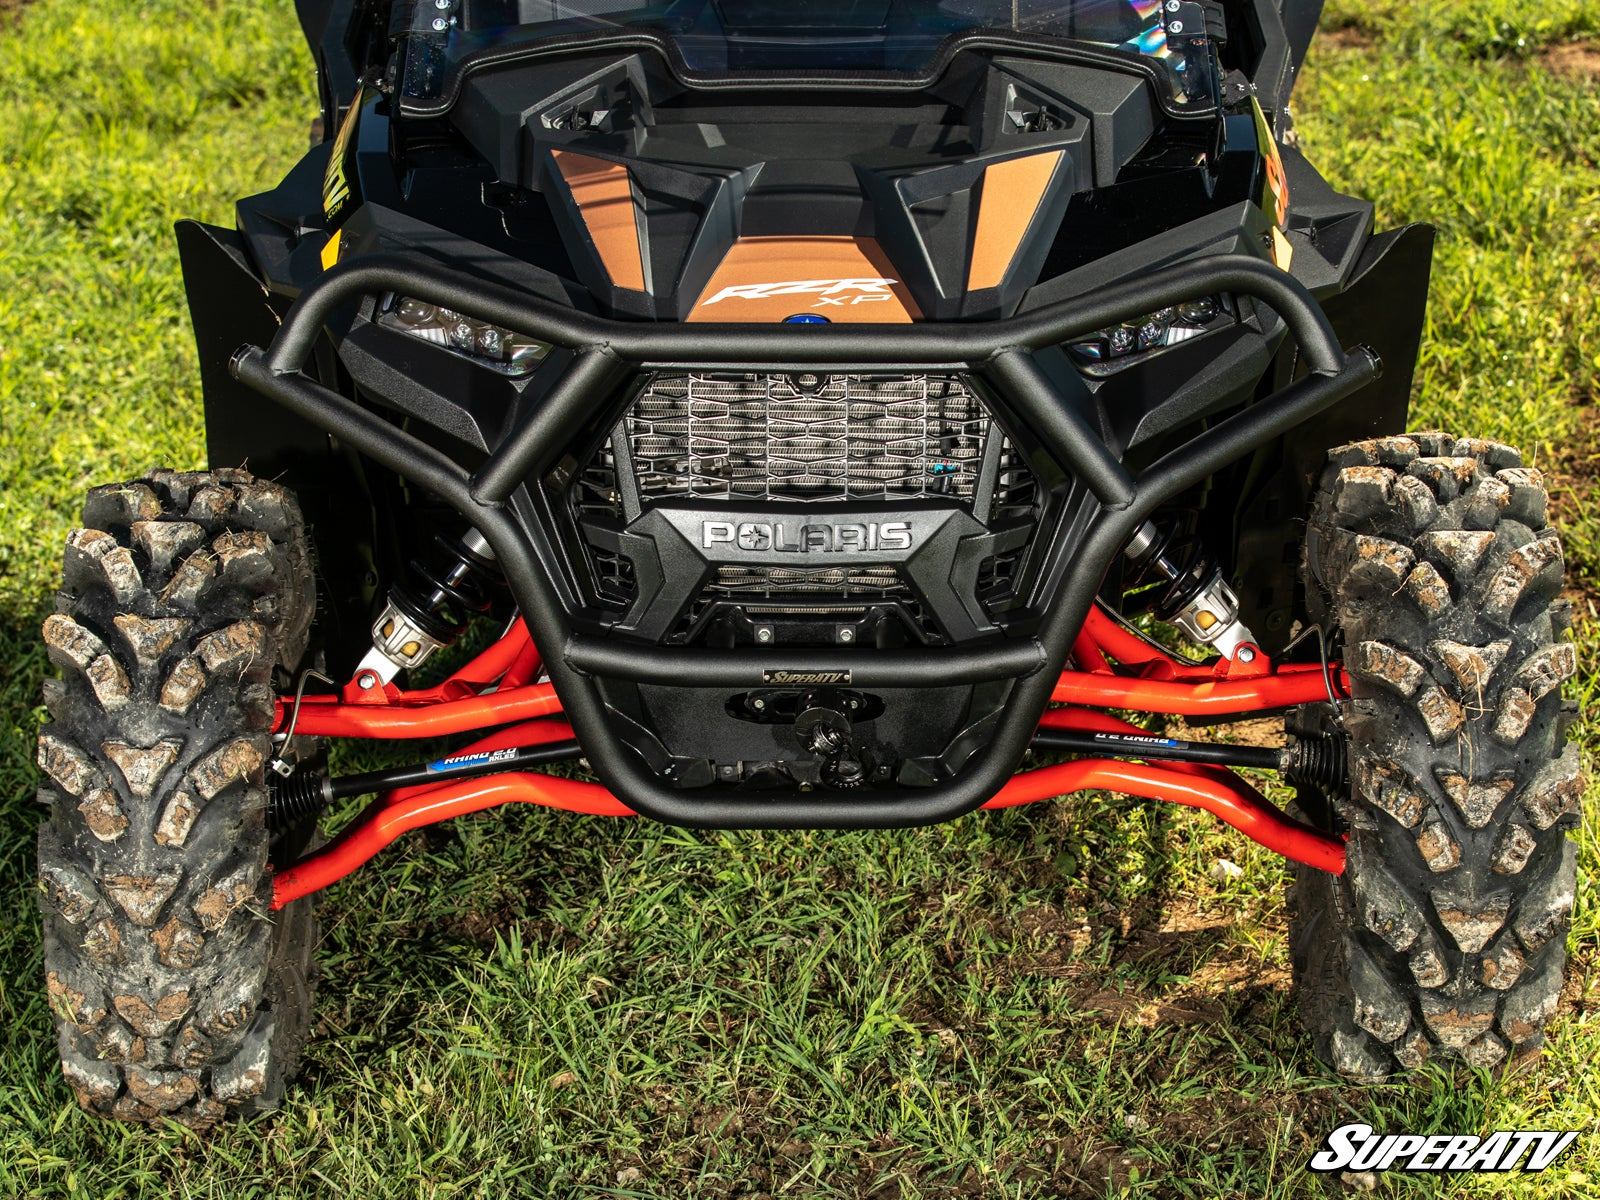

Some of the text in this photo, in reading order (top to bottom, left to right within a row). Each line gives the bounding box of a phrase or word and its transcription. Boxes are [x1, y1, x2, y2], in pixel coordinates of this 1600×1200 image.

[701, 278, 899, 306] RZR
[810, 294, 892, 308] XP
[702, 520, 912, 553] POLARIS
[769, 671, 843, 684] SUPERATV
[444, 752, 490, 765] RHINO
